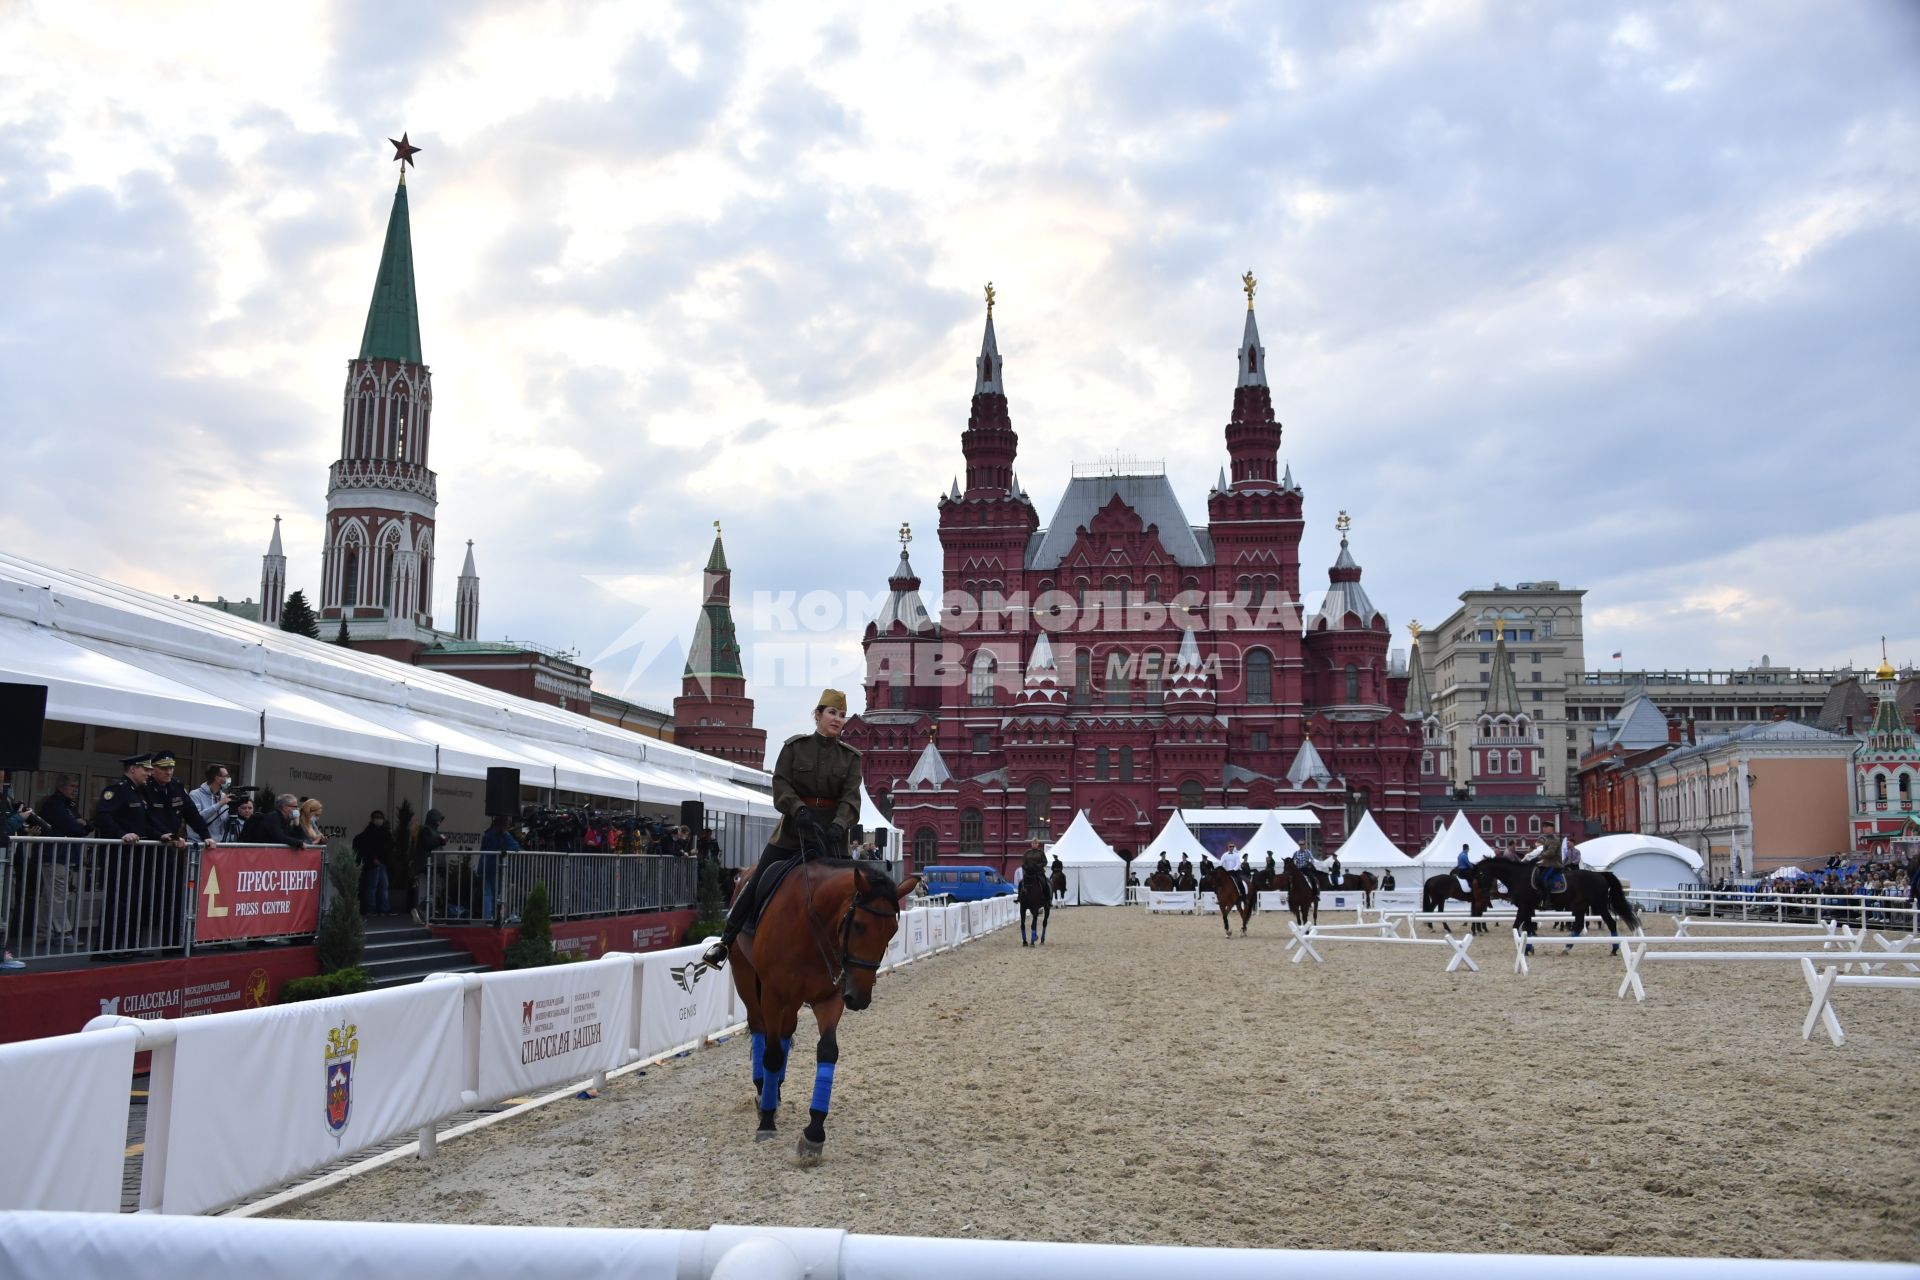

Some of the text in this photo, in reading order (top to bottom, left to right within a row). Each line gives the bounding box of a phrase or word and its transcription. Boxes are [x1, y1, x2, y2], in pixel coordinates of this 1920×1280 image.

[236, 870, 318, 895] ПРЕСС-ЦЕНТР
[235, 900, 291, 917] PRESS CENTRE
[123, 989, 180, 1013] СПАССКАЯ
[521, 1022, 602, 1065] СПАССКАЯ БАШНЯ
